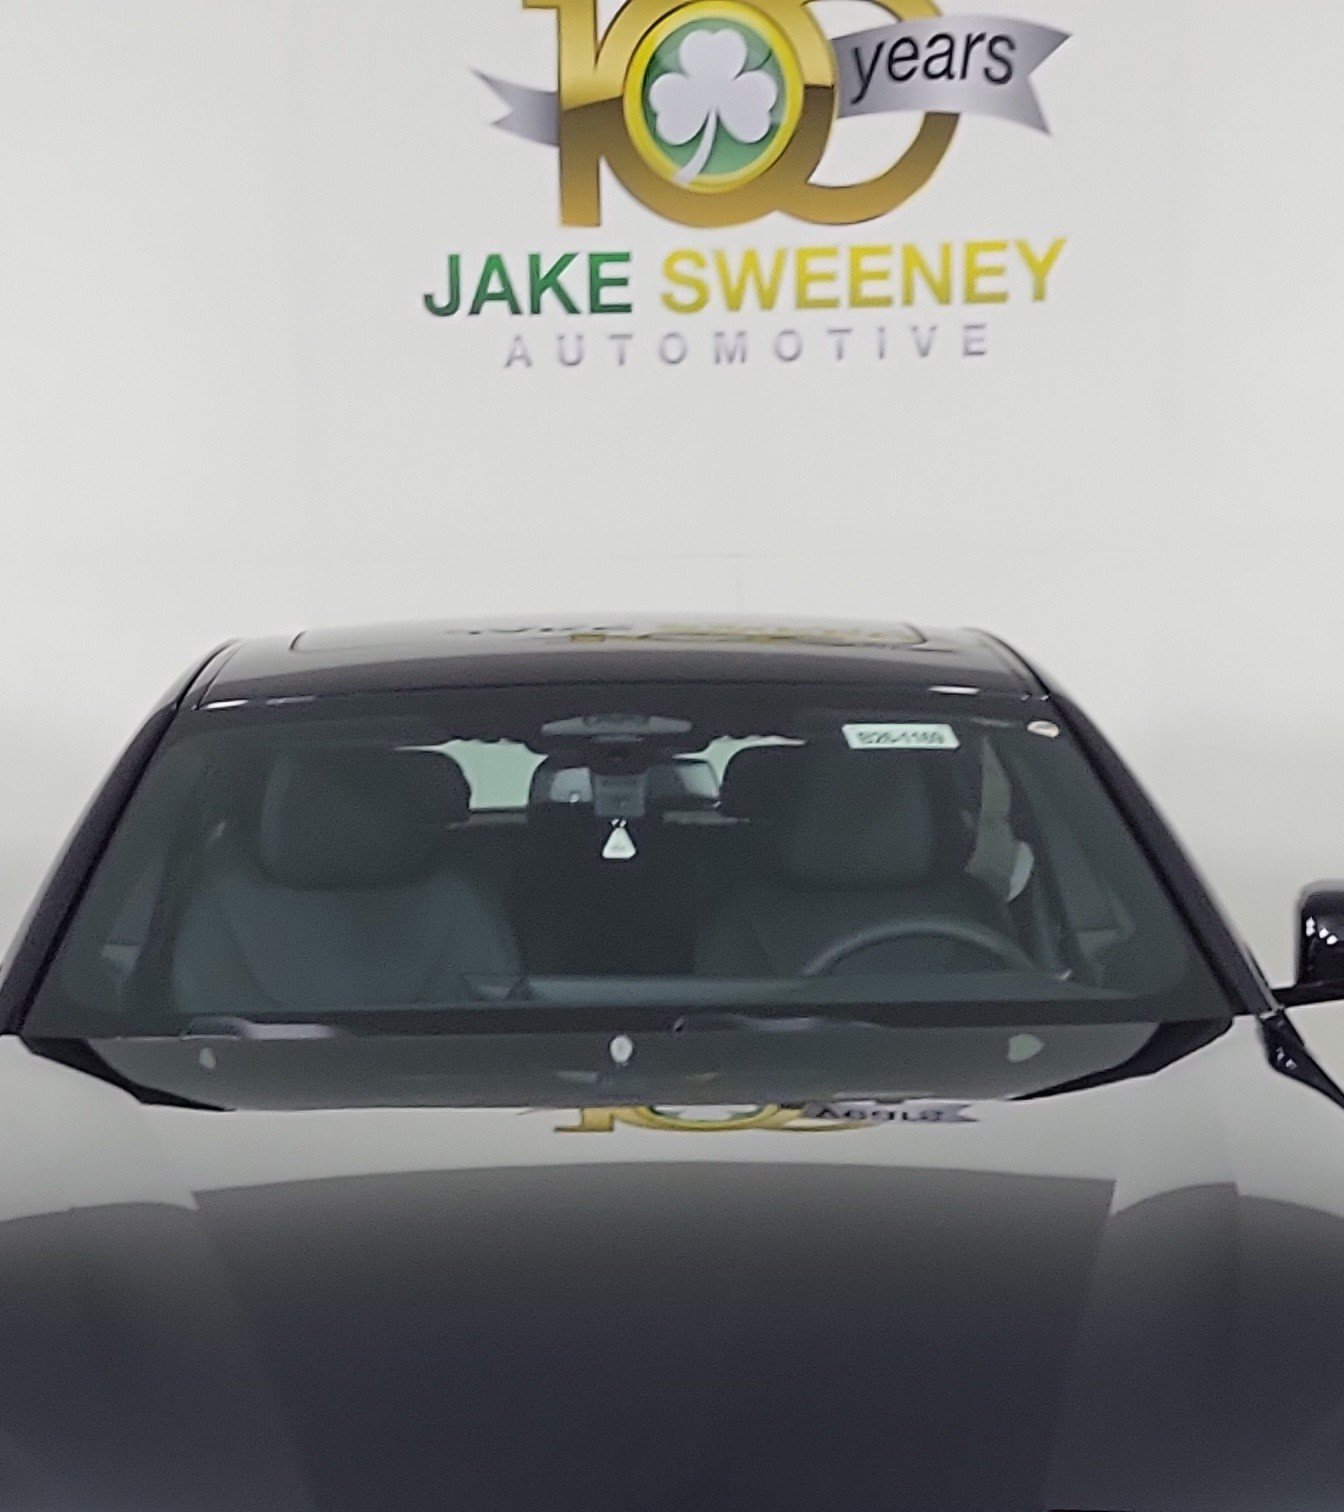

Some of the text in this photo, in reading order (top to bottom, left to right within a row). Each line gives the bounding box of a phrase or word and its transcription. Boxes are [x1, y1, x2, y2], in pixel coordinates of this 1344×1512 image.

[850, 30, 1017, 104] years
[422, 238, 1068, 317] JAKE SWEENEY
[504, 324, 990, 368] AUTOMOTIVE
